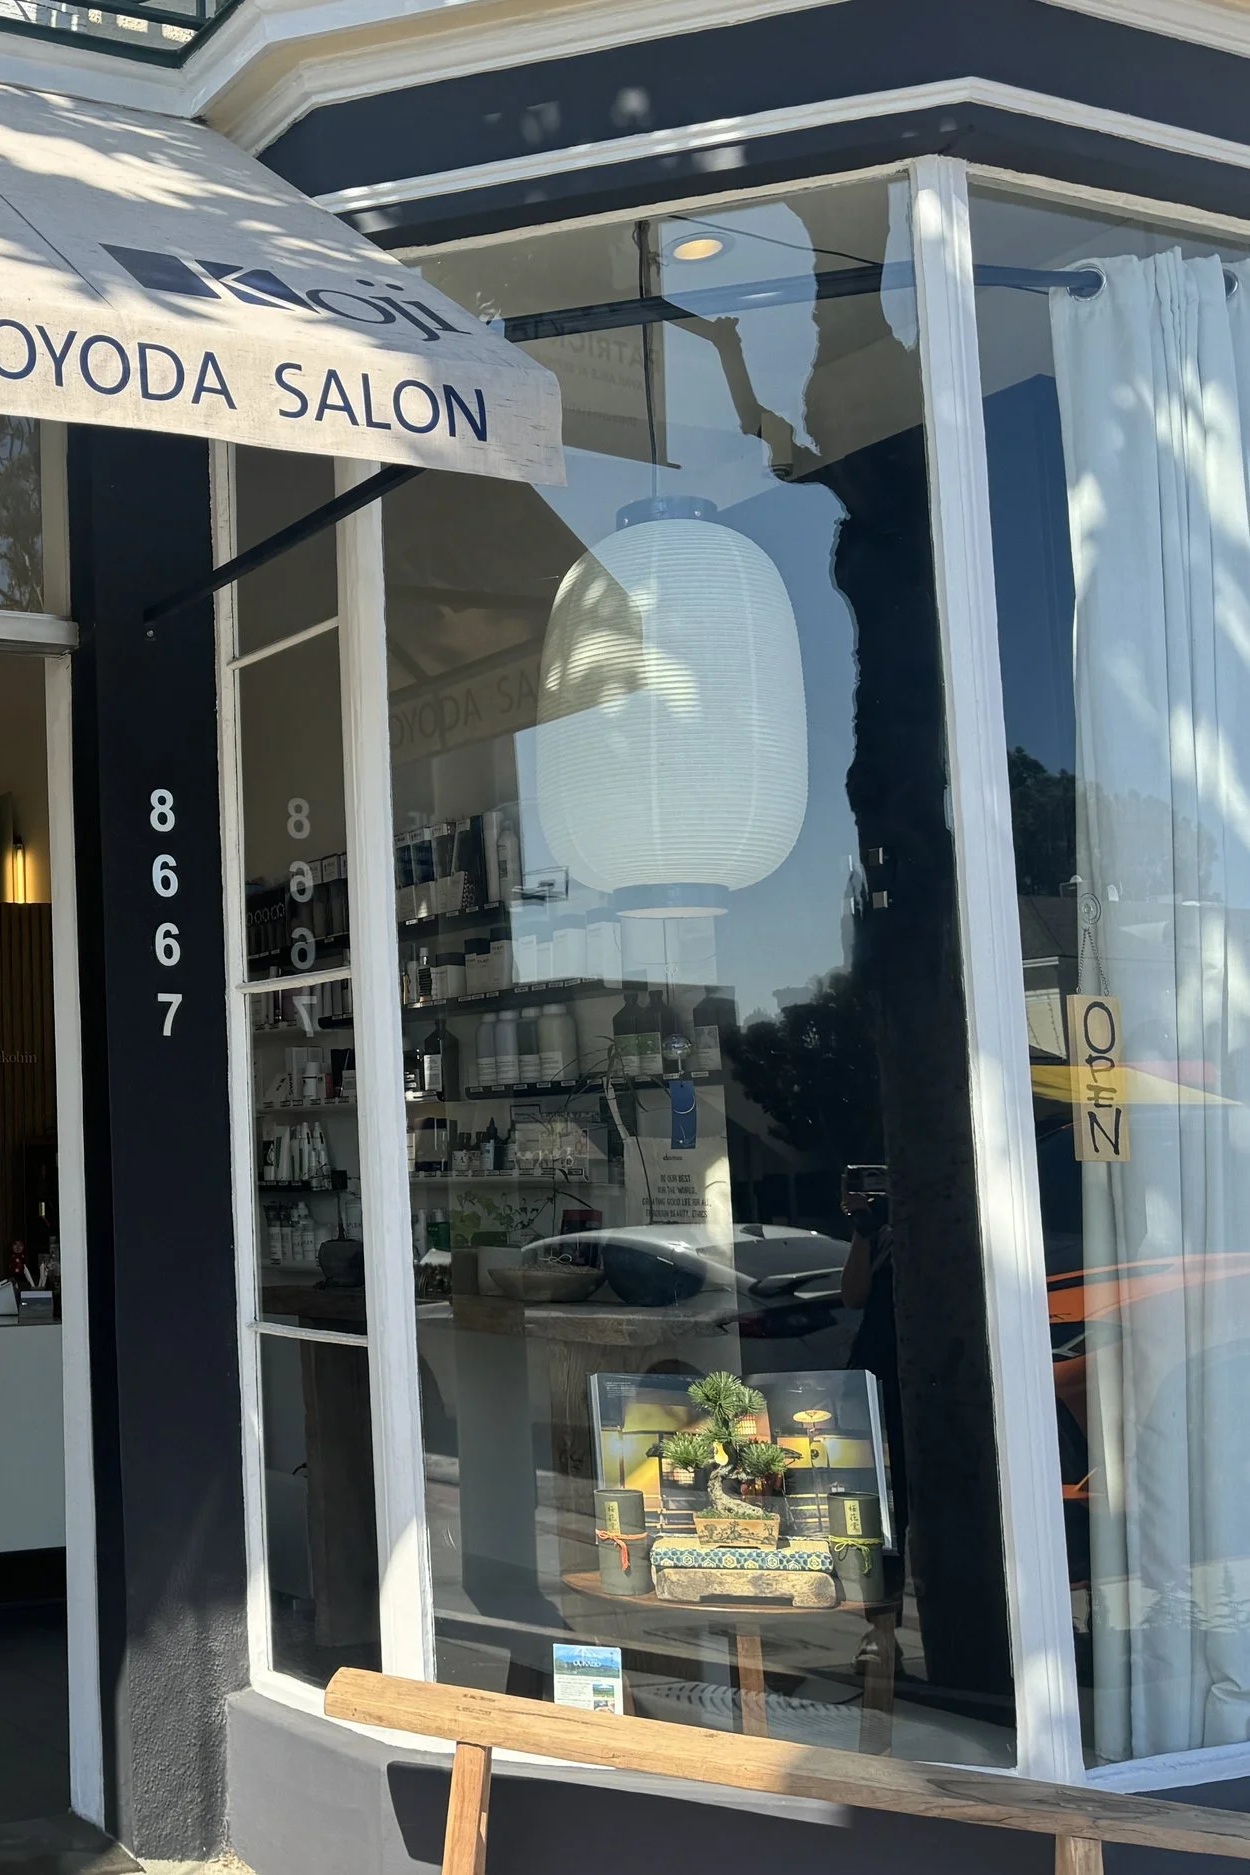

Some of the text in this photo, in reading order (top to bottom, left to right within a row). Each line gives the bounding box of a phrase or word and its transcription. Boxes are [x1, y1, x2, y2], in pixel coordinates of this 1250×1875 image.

[274, 361, 488, 443] SALON
[149, 788, 183, 1037] 8667
[1083, 1001, 1122, 1156] OPEN
